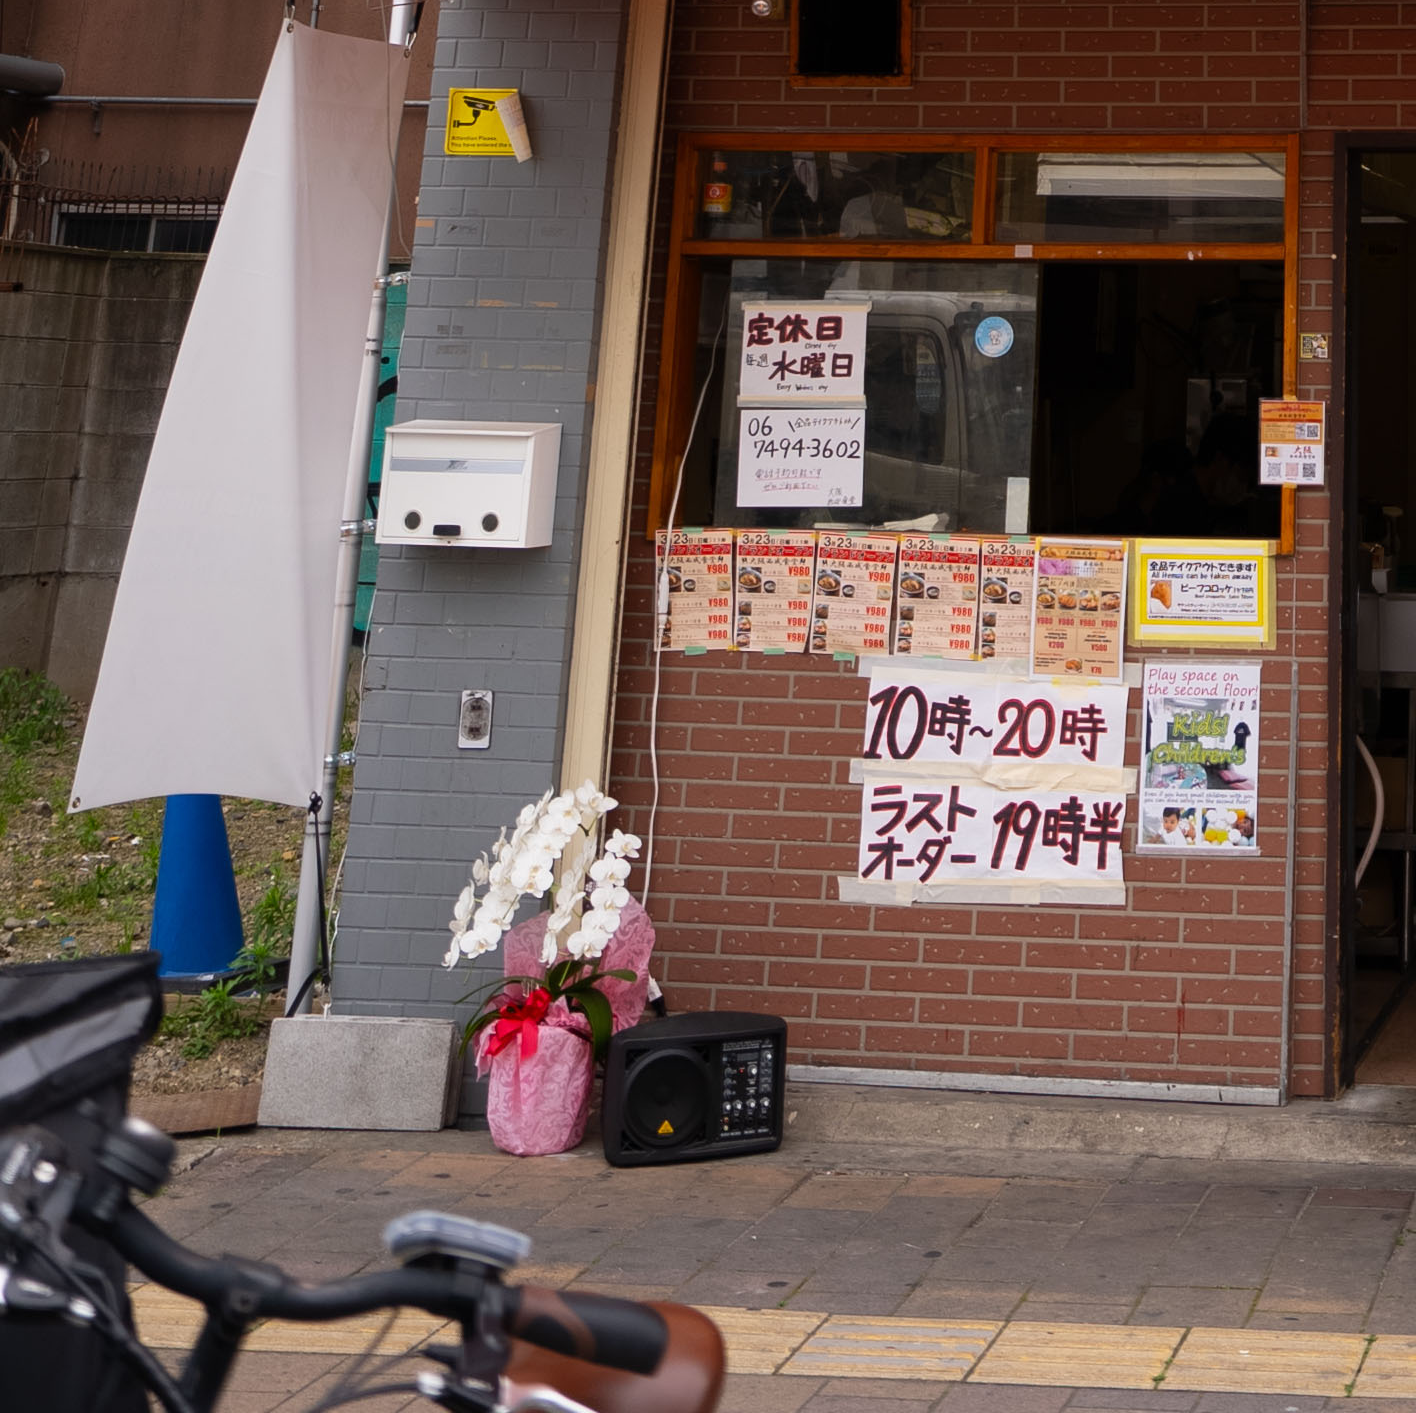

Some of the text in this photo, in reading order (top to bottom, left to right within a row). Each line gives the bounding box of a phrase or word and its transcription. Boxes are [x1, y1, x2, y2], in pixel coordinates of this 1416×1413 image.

[746, 312, 844, 348] 定休日
[746, 352, 769, 368] 毎週
[768, 350, 854, 382] 水曜日
[747, 415, 773, 437] 06
[753, 437, 861, 460] 7494-3602
[1180, 583, 1233, 593] ビーフコロッケ
[1148, 668, 1239, 685] Play space on
[1148, 683, 1259, 697] the second floor!
[1173, 712, 1230, 738] Kids!
[1152, 741, 1247, 766] Children's
[870, 785, 977, 836] ラスト
[990, 795, 1124, 871] 19時半
[861, 835, 977, 884] オーダー
